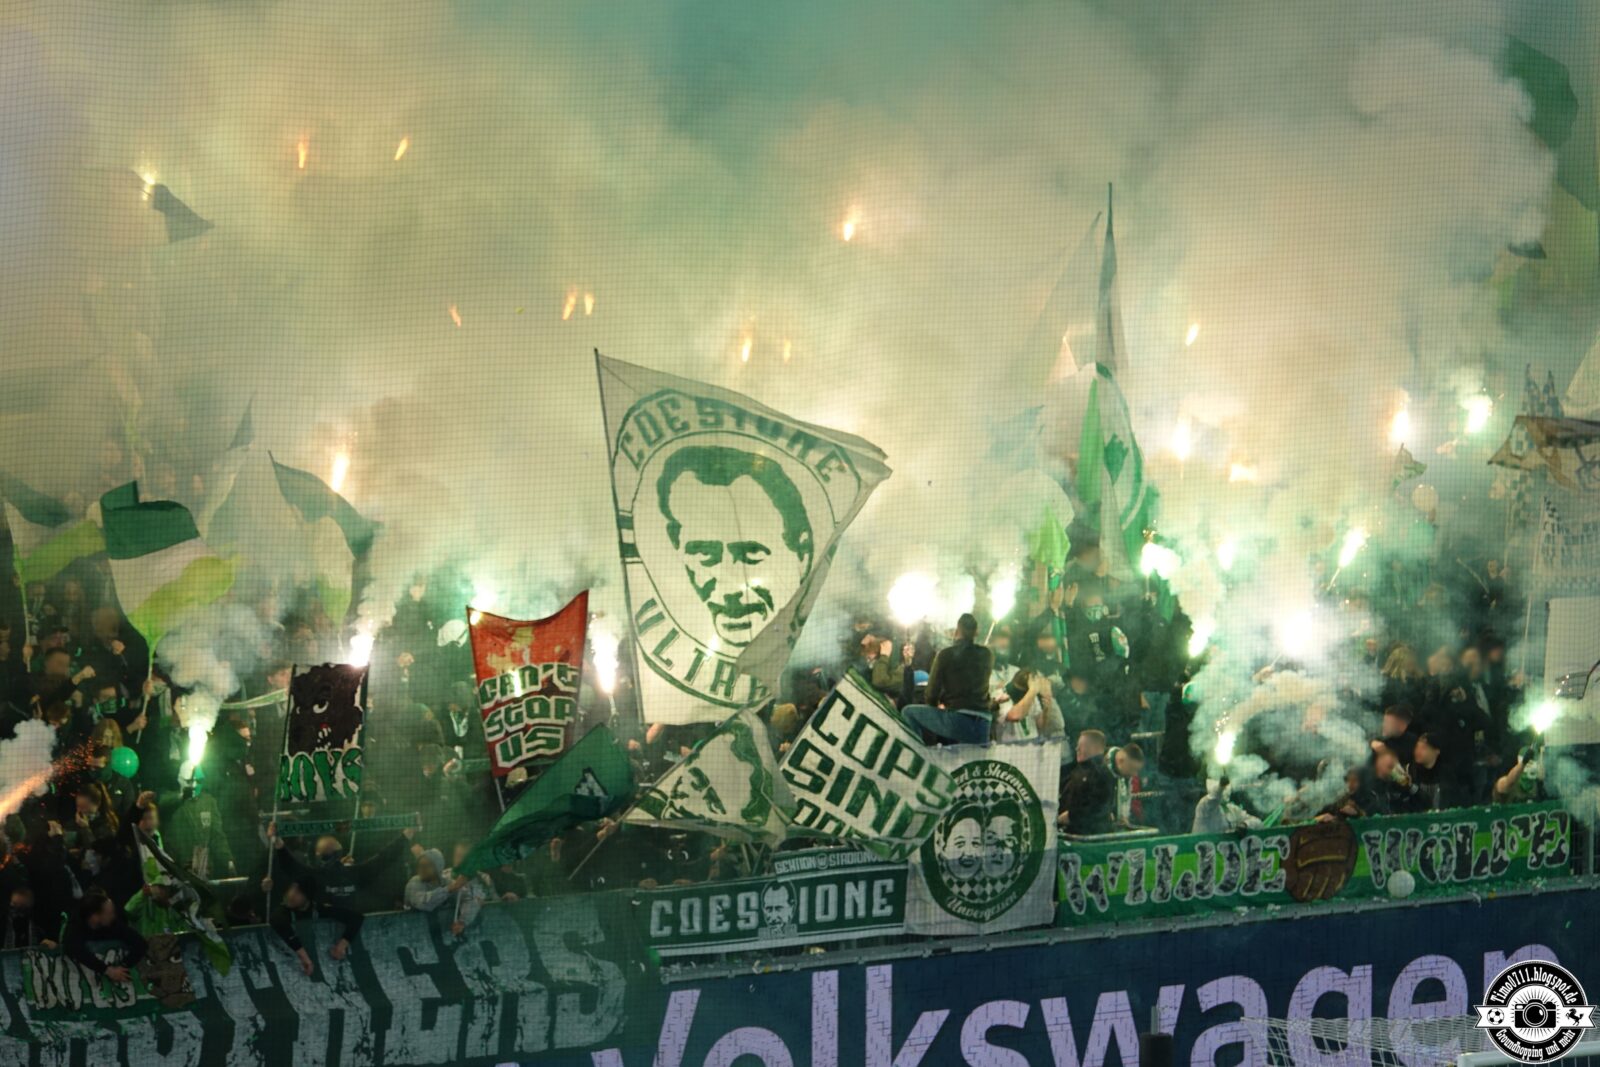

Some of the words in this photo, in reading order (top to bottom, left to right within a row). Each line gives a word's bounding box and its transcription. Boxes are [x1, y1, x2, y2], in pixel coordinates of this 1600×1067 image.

[495, 726, 564, 768] US
[782, 738, 941, 839] SIND
[811, 688, 958, 810] COPS
[1059, 834, 1290, 915] WILDE
